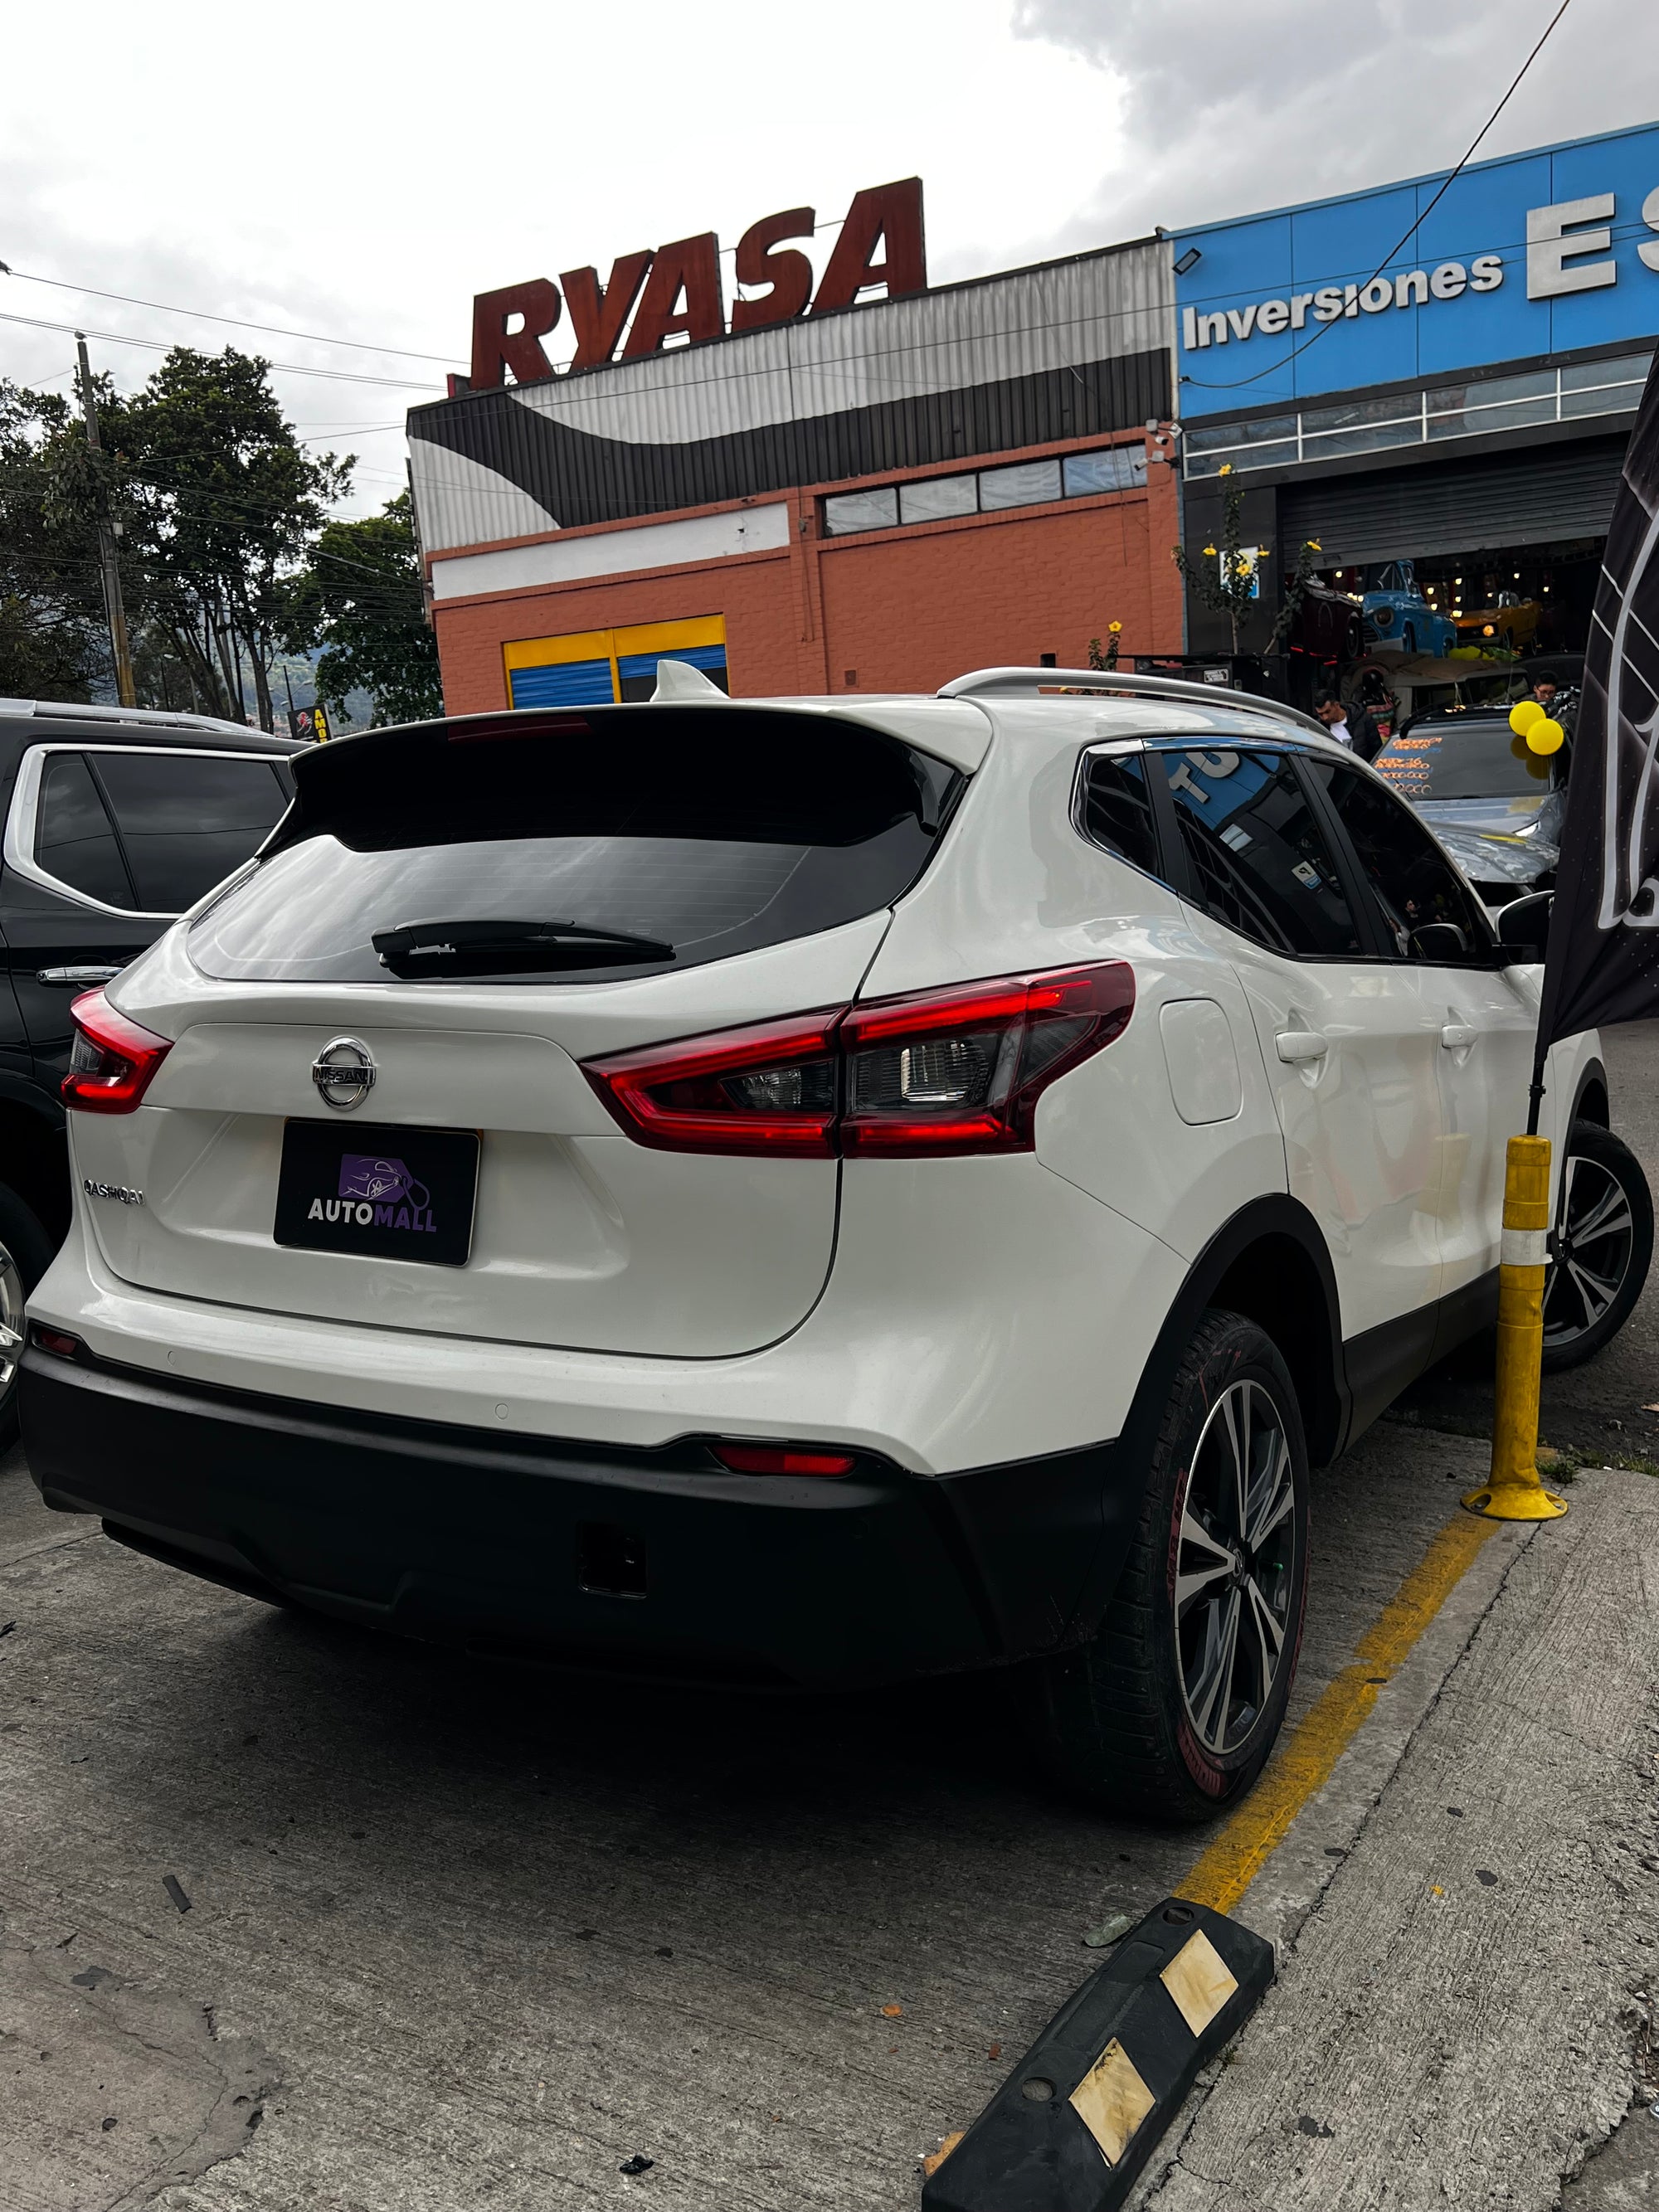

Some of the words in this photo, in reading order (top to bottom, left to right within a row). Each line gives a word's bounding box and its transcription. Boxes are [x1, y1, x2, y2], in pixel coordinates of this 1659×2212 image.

[469, 176, 927, 391] RYASA
[1182, 255, 1504, 349] Inversiones
[1526, 185, 1659, 302] E
[314, 1067, 368, 1082] NISSAN
[84, 1179, 145, 1205] QASHQAI
[308, 1198, 437, 1232] AUTOMALL
